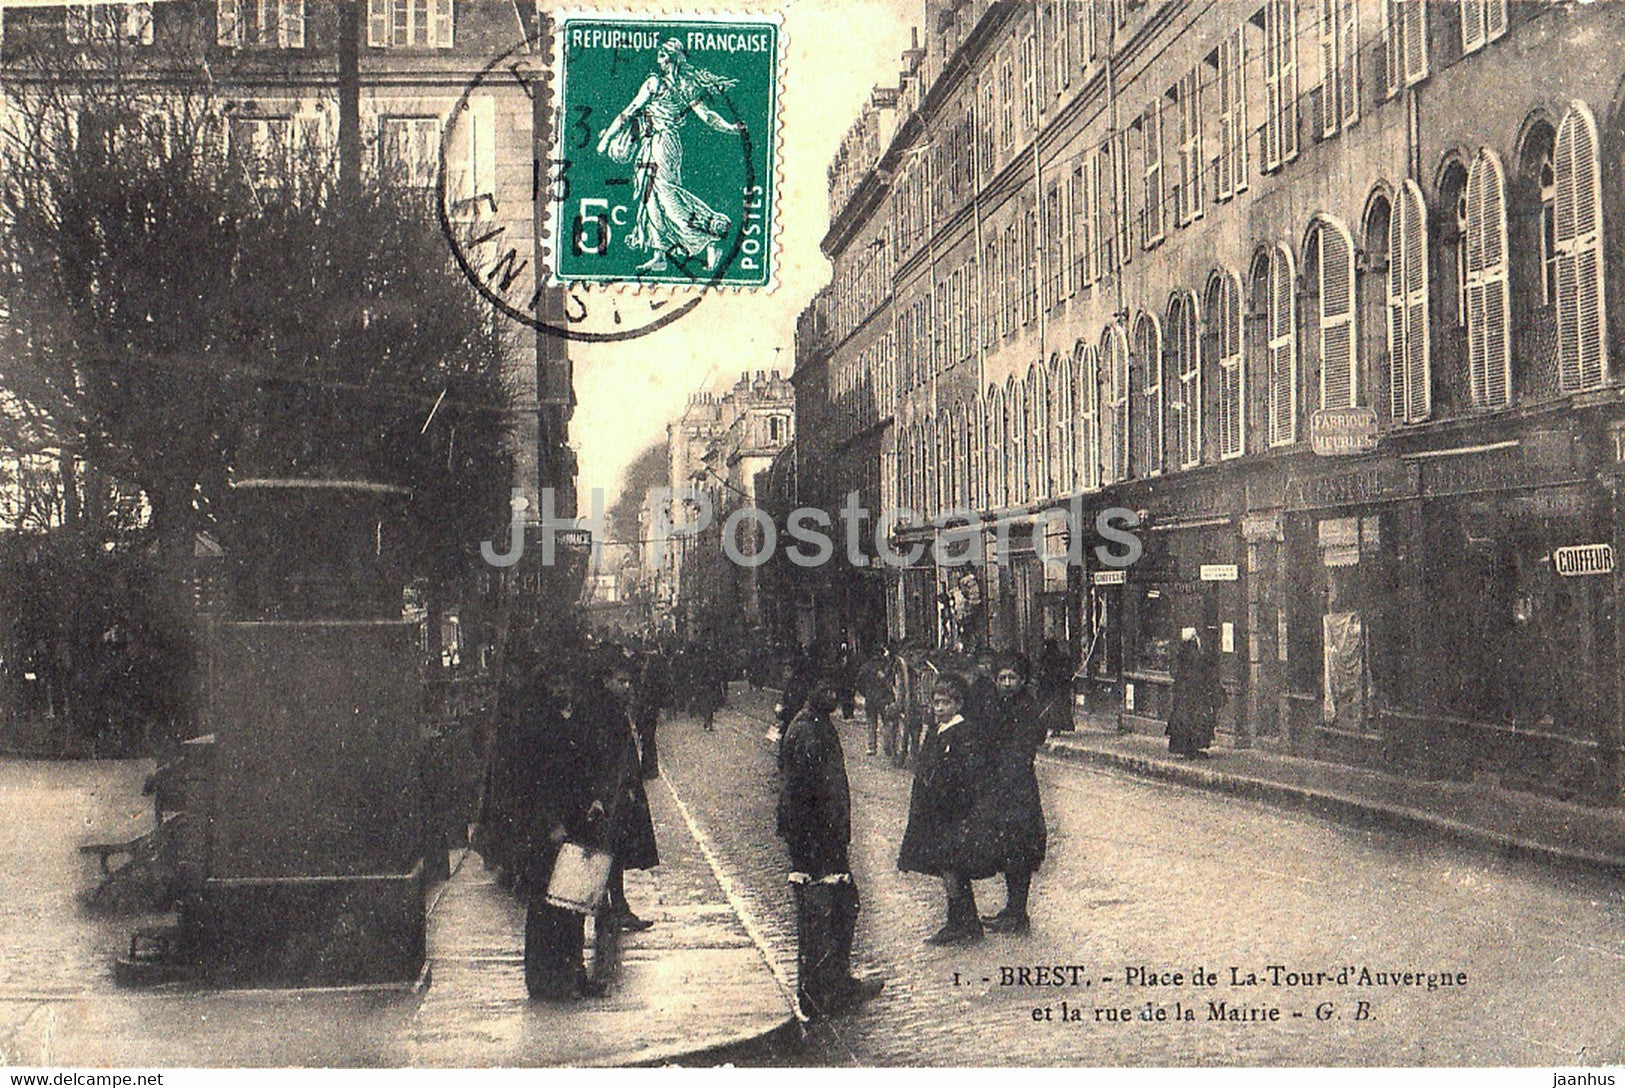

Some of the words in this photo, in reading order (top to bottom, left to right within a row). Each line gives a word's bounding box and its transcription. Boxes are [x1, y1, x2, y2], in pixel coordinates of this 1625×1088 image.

[686, 31, 769, 54] FRANÇAISE
[740, 184, 764, 270] POSTES
[1559, 547, 1612, 572] COIFFEUR
